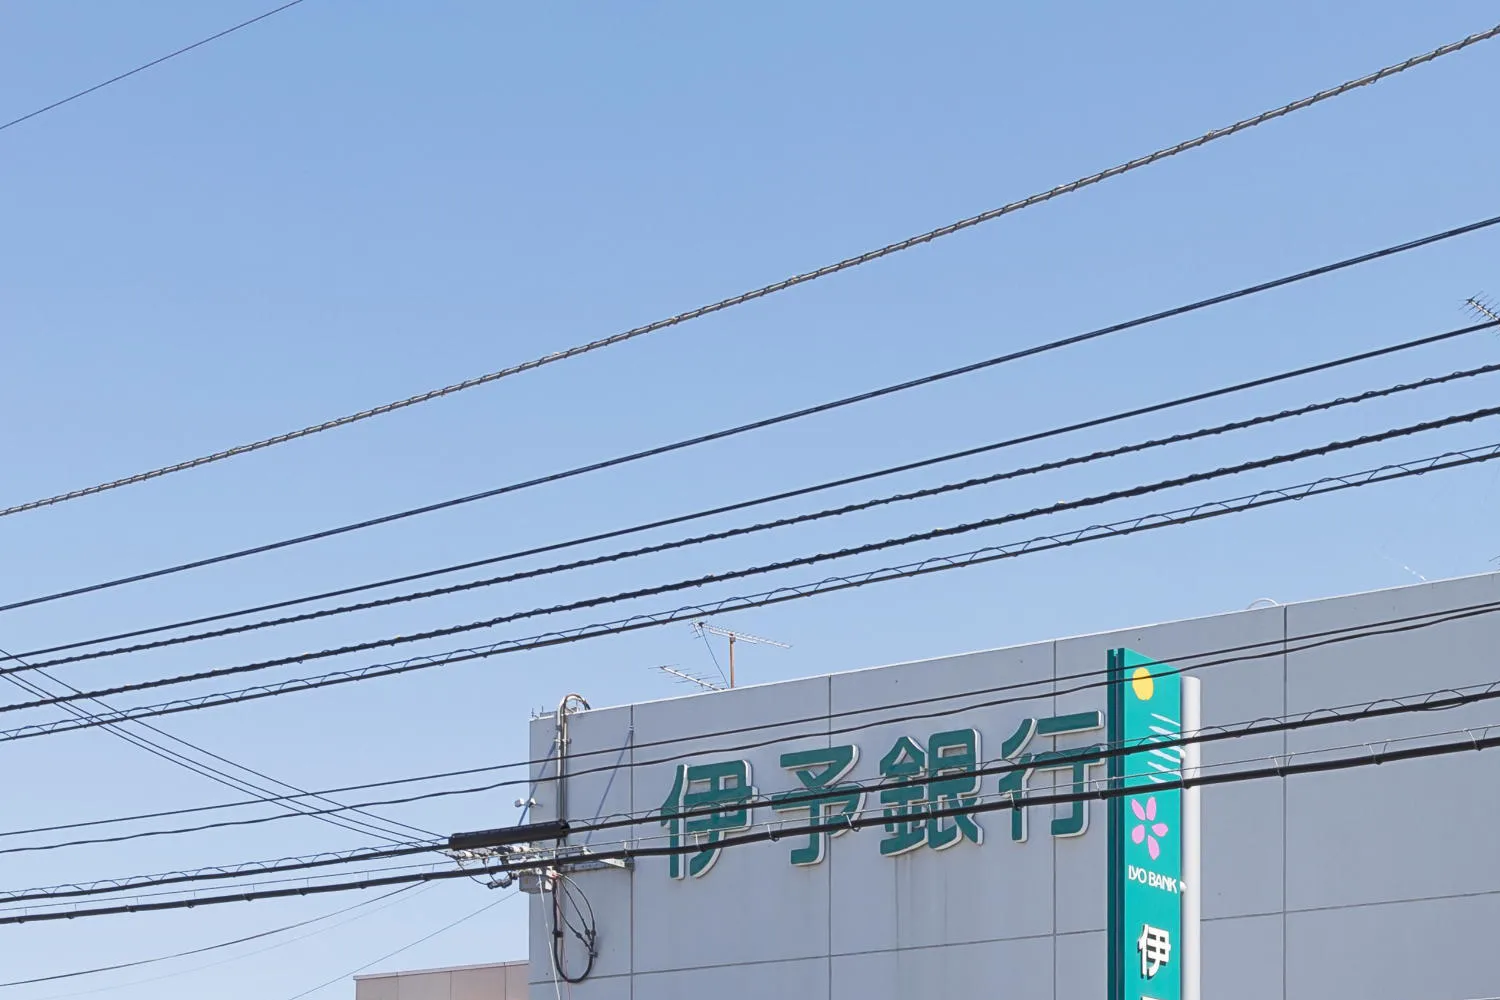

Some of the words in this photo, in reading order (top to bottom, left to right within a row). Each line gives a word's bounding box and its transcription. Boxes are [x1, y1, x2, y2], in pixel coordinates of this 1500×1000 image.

[660, 711, 1105, 880] 伊予銀行
[1128, 865, 1147, 884] IYO
[1148, 871, 1178, 894] BANK
